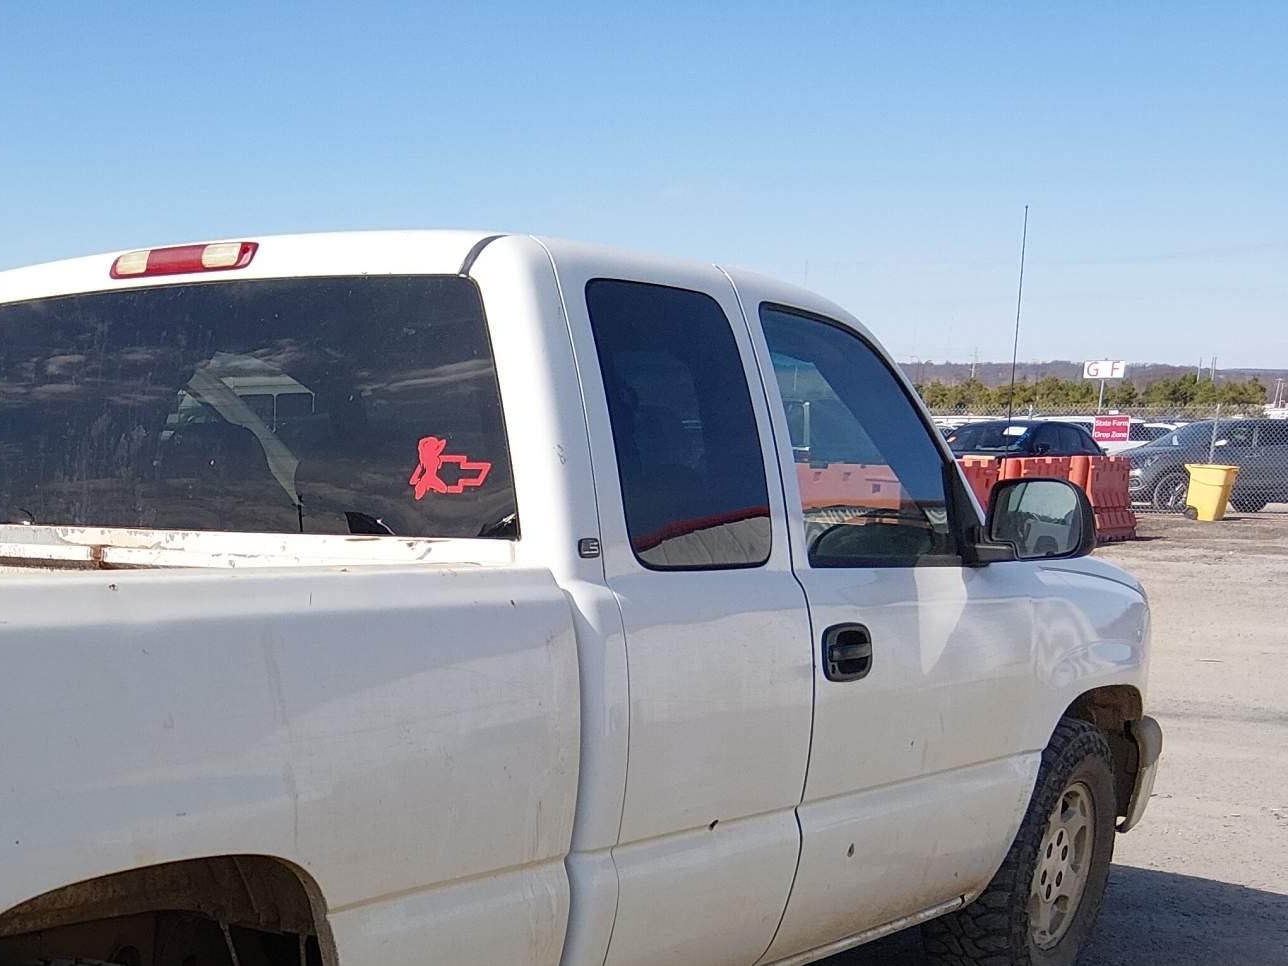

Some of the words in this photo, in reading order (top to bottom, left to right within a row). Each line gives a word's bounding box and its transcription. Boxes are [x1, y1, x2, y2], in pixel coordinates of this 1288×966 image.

[1087, 361, 1099, 377] G
[1111, 361, 1121, 377] F
[1094, 431, 1111, 439] Drop
